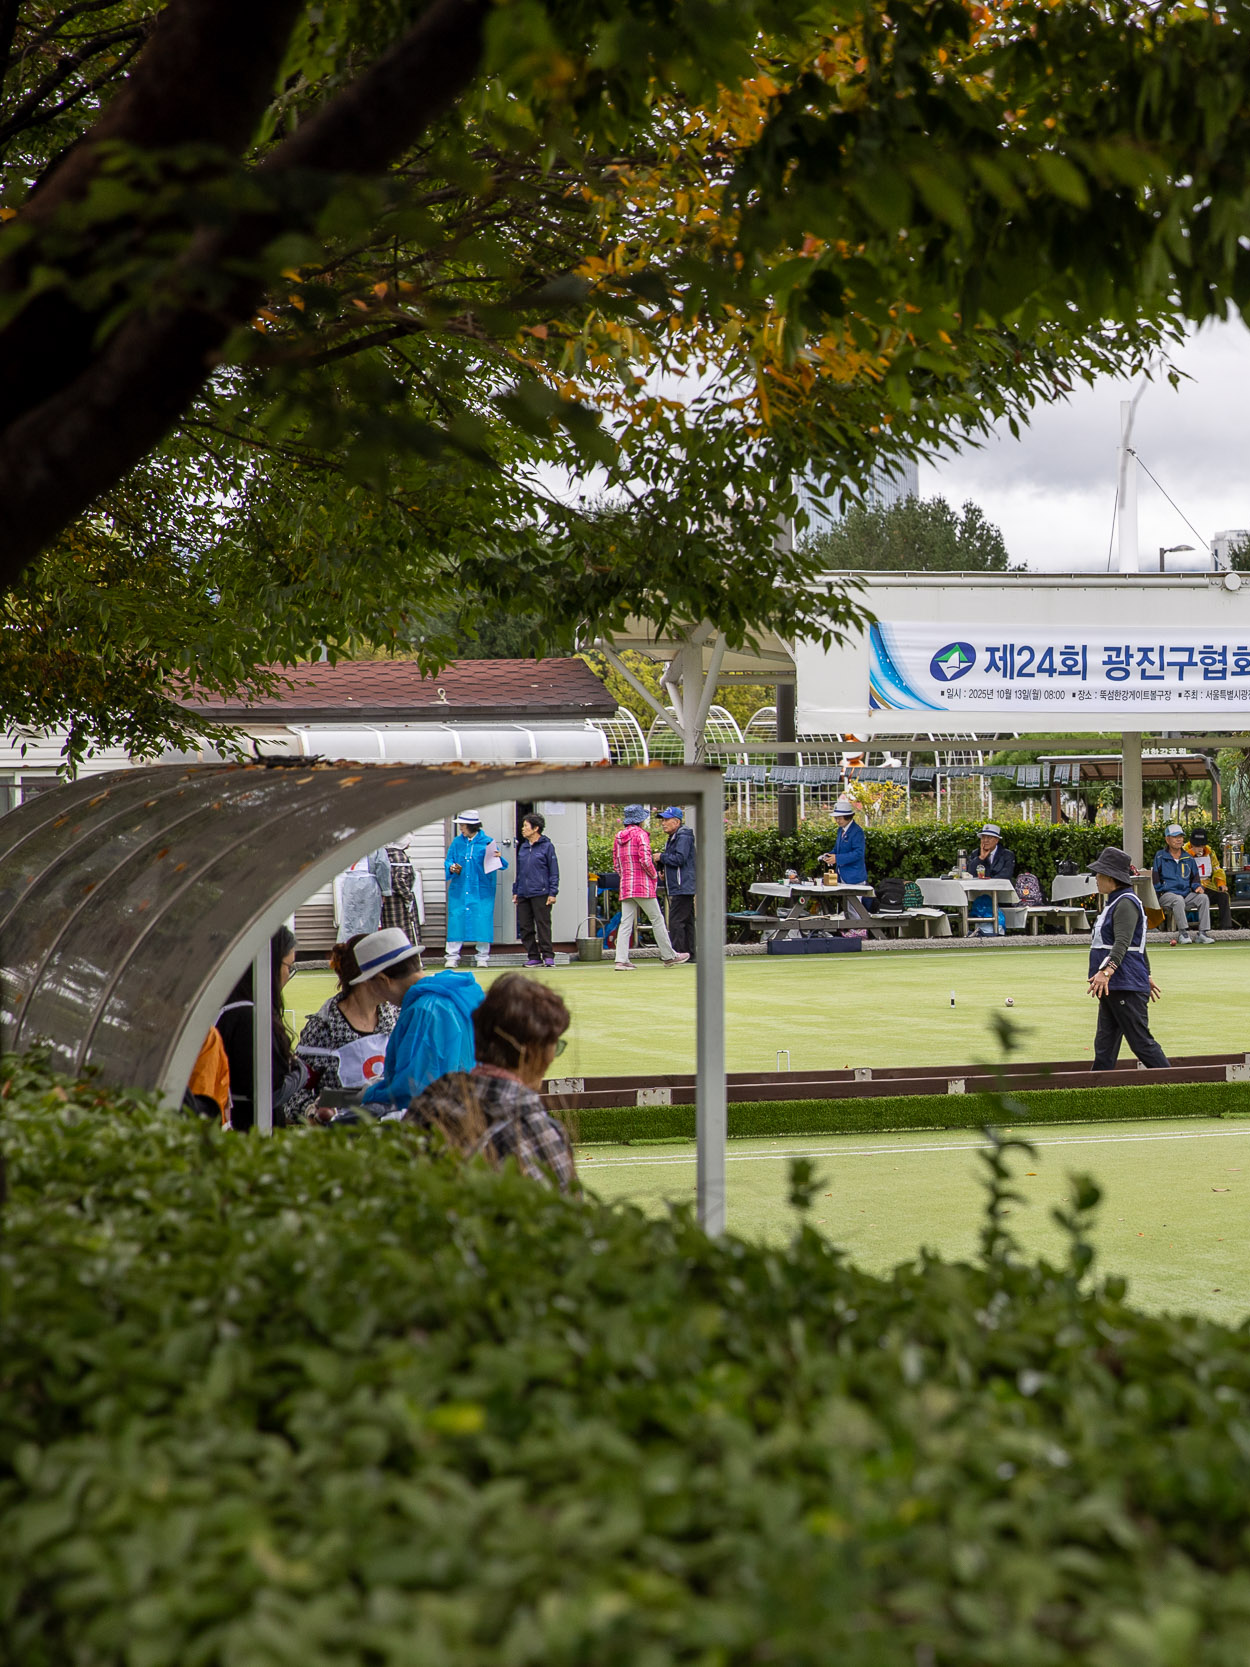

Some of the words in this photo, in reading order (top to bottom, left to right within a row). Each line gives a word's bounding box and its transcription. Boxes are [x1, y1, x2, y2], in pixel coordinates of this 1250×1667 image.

[983, 643, 1088, 681] 제24회
[947, 688, 962, 700] 일시
[968, 689, 994, 700] 2025년
[996, 689, 1013, 700] 10월
[1014, 689, 1042, 701] 13일(월)
[1044, 689, 1066, 700] 08:00
[1077, 690, 1093, 701] 장소
[1099, 690, 1172, 702] 뚝섬한강게이트볼구장
[1183, 690, 1199, 701] 주최
[1197, 863, 1206, 876] 1
